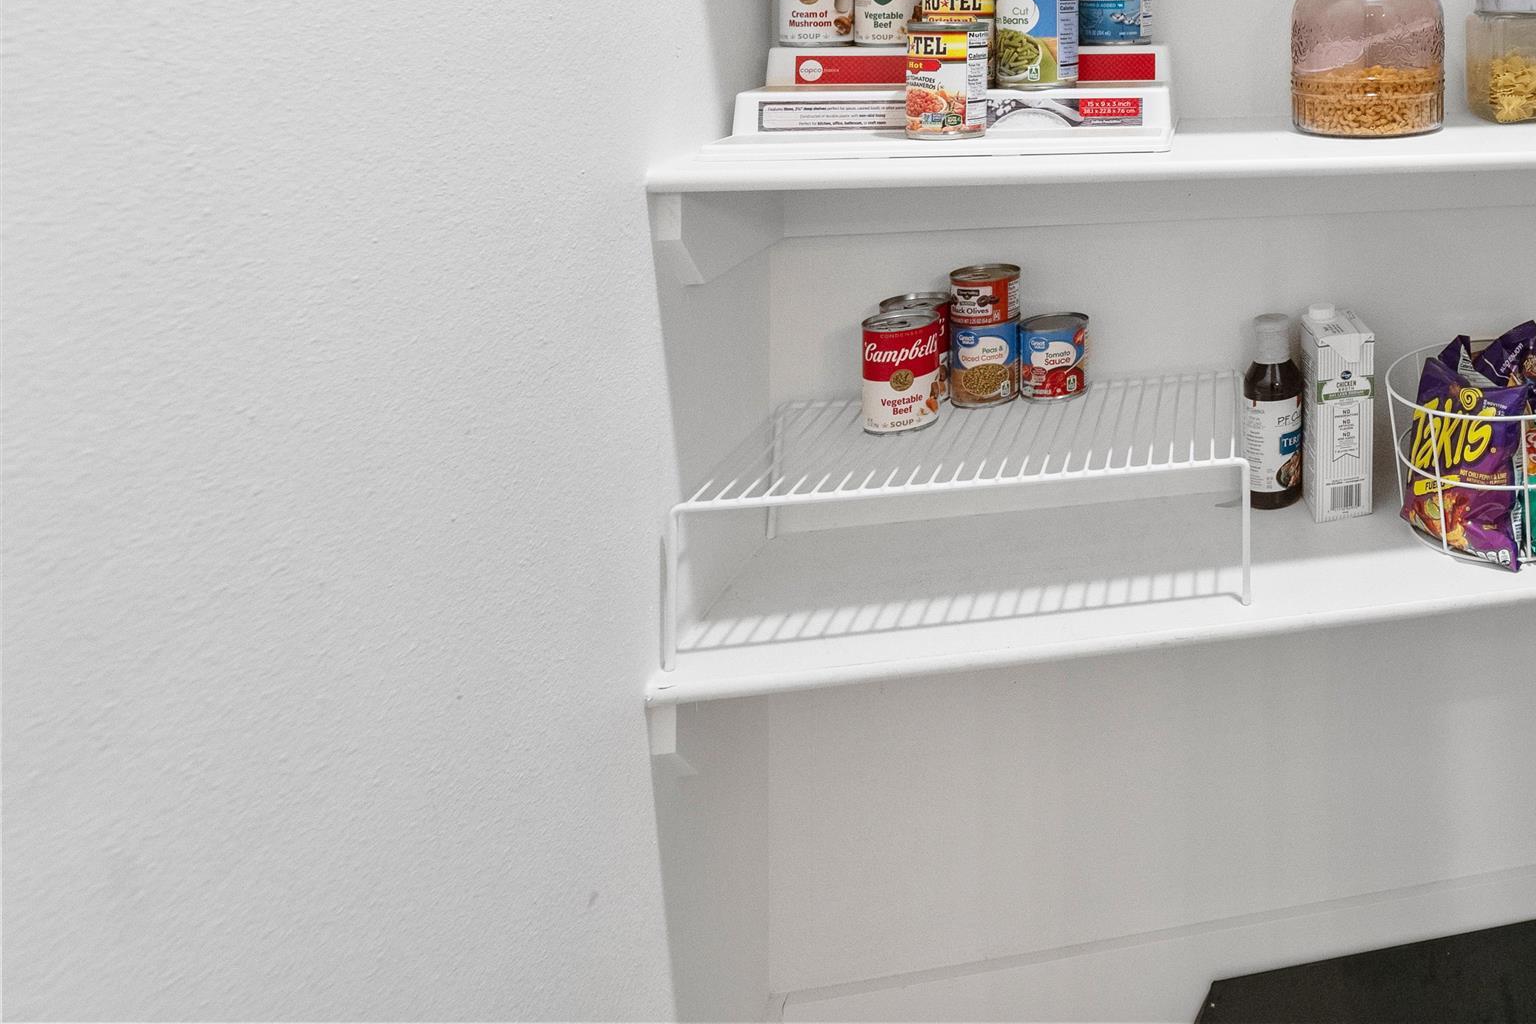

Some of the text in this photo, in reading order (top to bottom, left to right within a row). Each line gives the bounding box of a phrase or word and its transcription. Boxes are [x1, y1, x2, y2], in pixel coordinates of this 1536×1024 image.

[791, 10, 828, 18] Cream of
[864, 11, 904, 20] Vegetable
[1012, 7, 1029, 16] Cut
[789, 19, 832, 28] Mushroom
[873, 21, 892, 29] Beef
[1002, 16, 1029, 25] Beans
[907, 36, 947, 55] TEL
[966, 306, 989, 314] Olives
[958, 334, 975, 342] Great
[1030, 340, 1046, 348] Great
[864, 333, 938, 367] Campbell's
[961, 352, 1004, 362] Diced Carrots
[1045, 350, 1071, 360] Tomato
[1044, 357, 1071, 366] Sauce
[1336, 380, 1357, 388] CHICKEN
[880, 393, 924, 408] Vegetable
[892, 405, 913, 416] Beef
[889, 419, 914, 427] SOUP
[1408, 397, 1497, 484] Takis
[1425, 479, 1446, 490] FUE
